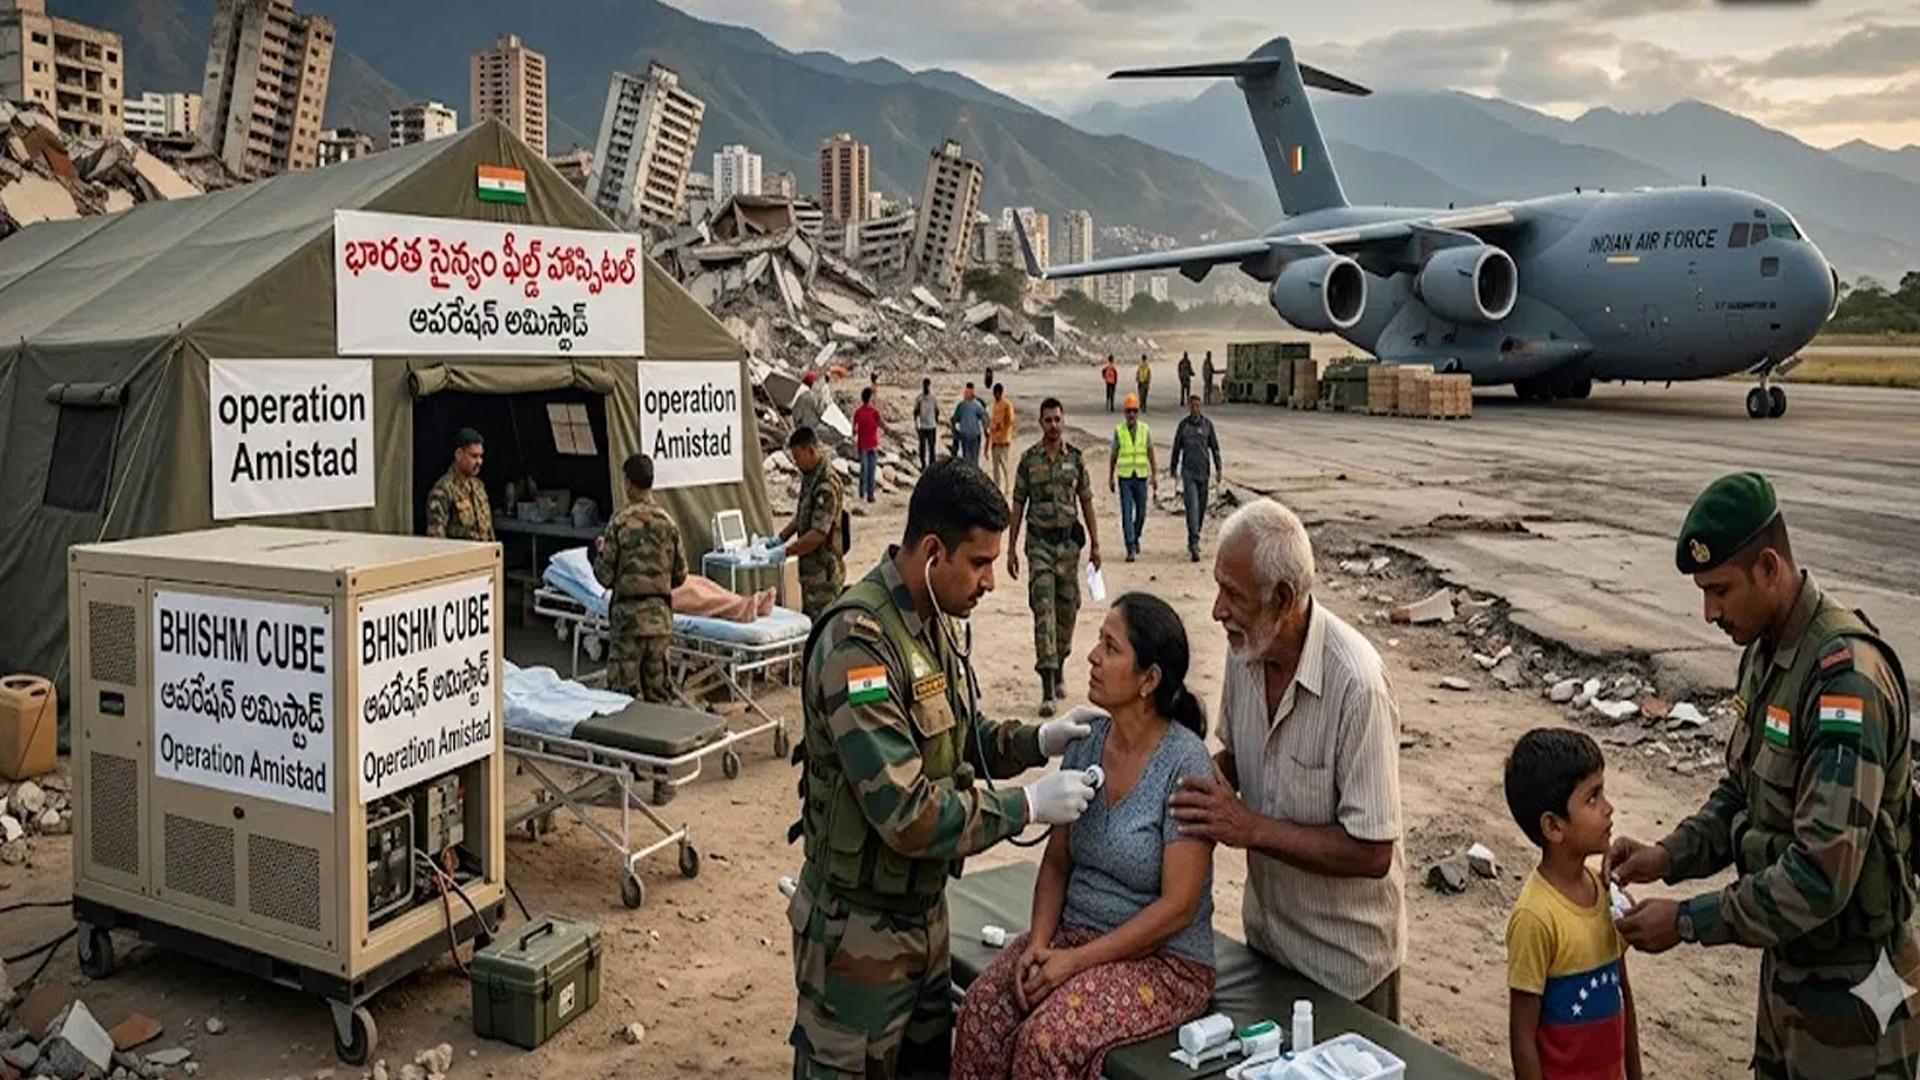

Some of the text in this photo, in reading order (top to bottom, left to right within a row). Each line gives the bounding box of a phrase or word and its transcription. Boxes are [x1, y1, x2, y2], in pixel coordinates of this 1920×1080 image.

[1635, 231, 1660, 251] AIR
[1664, 228, 1719, 249] FORCE
[345, 237, 422, 276] భారత
[428, 239, 498, 290] సైన్యం
[502, 232, 541, 298] ఫీల్డ్
[409, 296, 499, 340] ఆపరేషన్
[219, 384, 365, 434] operation
[644, 382, 737, 422] operation
[231, 437, 357, 483] Amistad
[653, 424, 731, 459] Amistad
[160, 608, 326, 674] BHISHM CUBE
[363, 593, 490, 666] BHISHM CUBE
[161, 672, 236, 723] ఆపరేషన్
[161, 733, 326, 793] Operation Amistad
[363, 711, 491, 788] Operation Amistad
